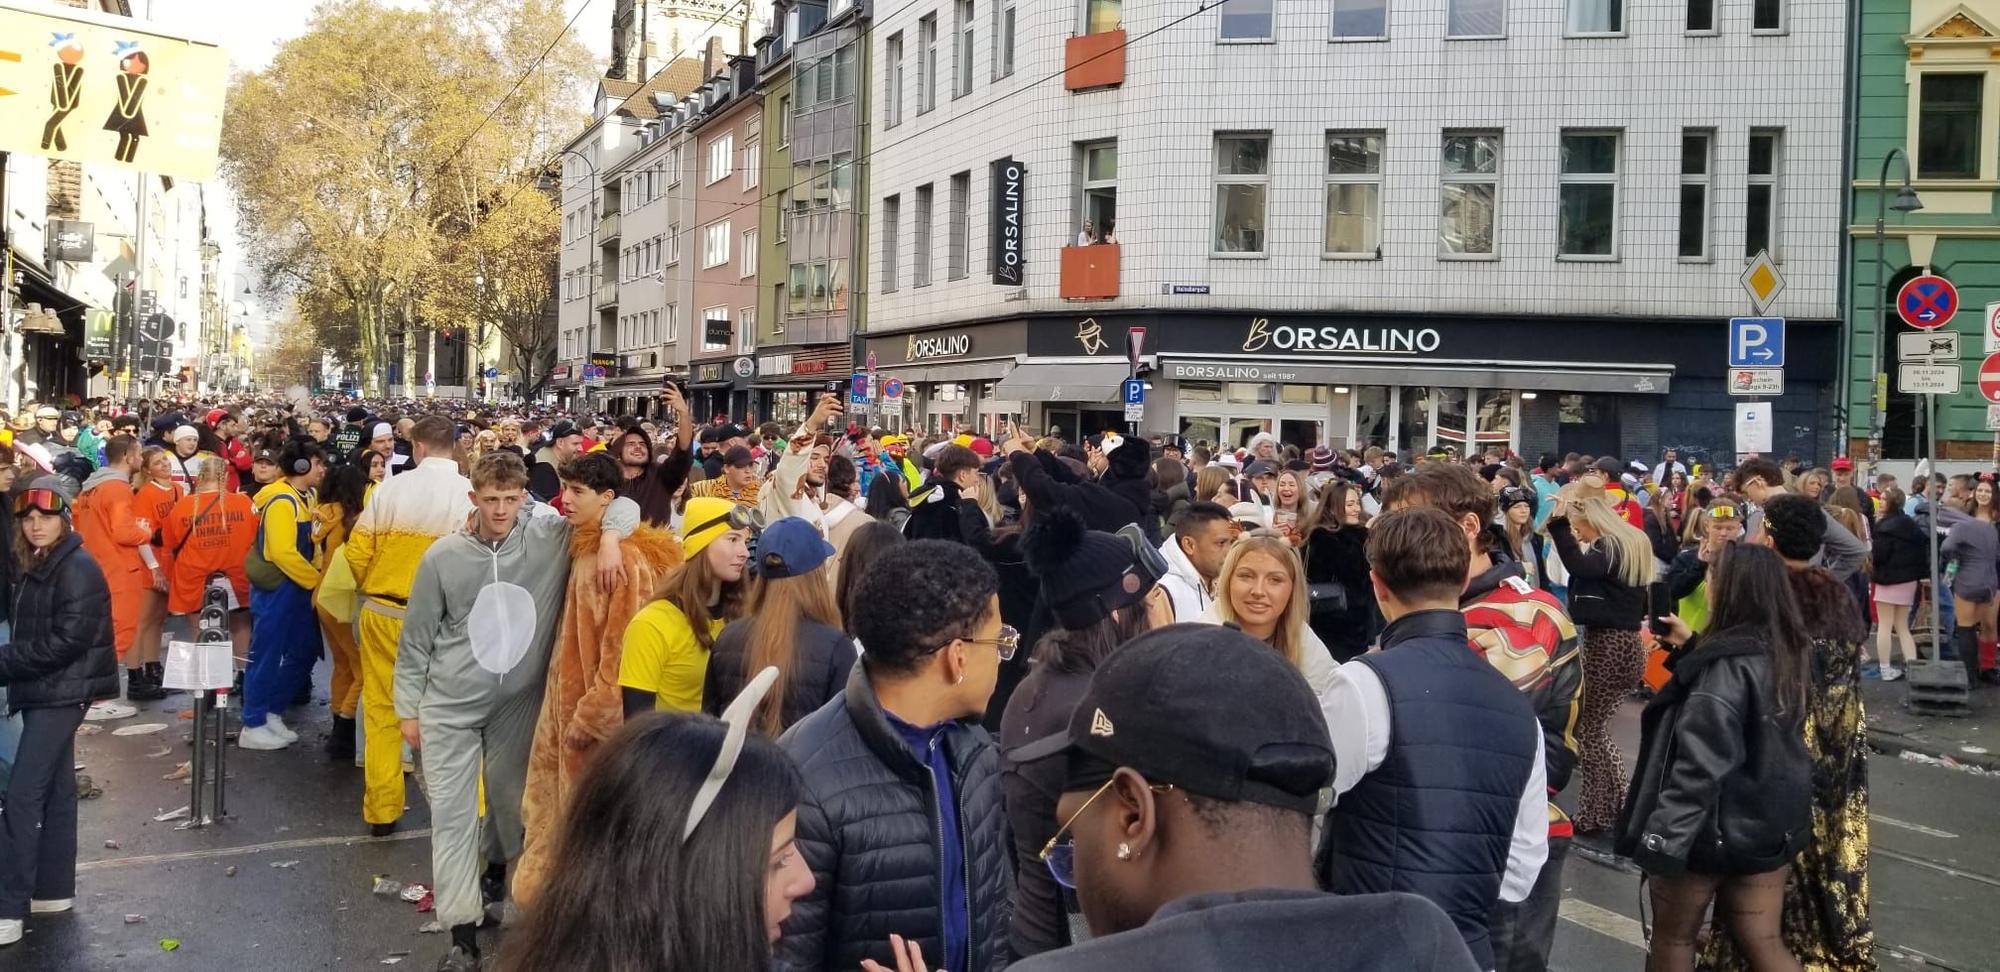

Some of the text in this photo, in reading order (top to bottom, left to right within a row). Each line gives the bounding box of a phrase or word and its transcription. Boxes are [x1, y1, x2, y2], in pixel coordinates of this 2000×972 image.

[1000, 166, 1019, 282] BORSALINO
[905, 334, 968, 361] BORSALINO
[1243, 317, 1440, 352] BORSALINO
[1739, 324, 1767, 360] P
[1176, 366, 1259, 379] BORSALINO
